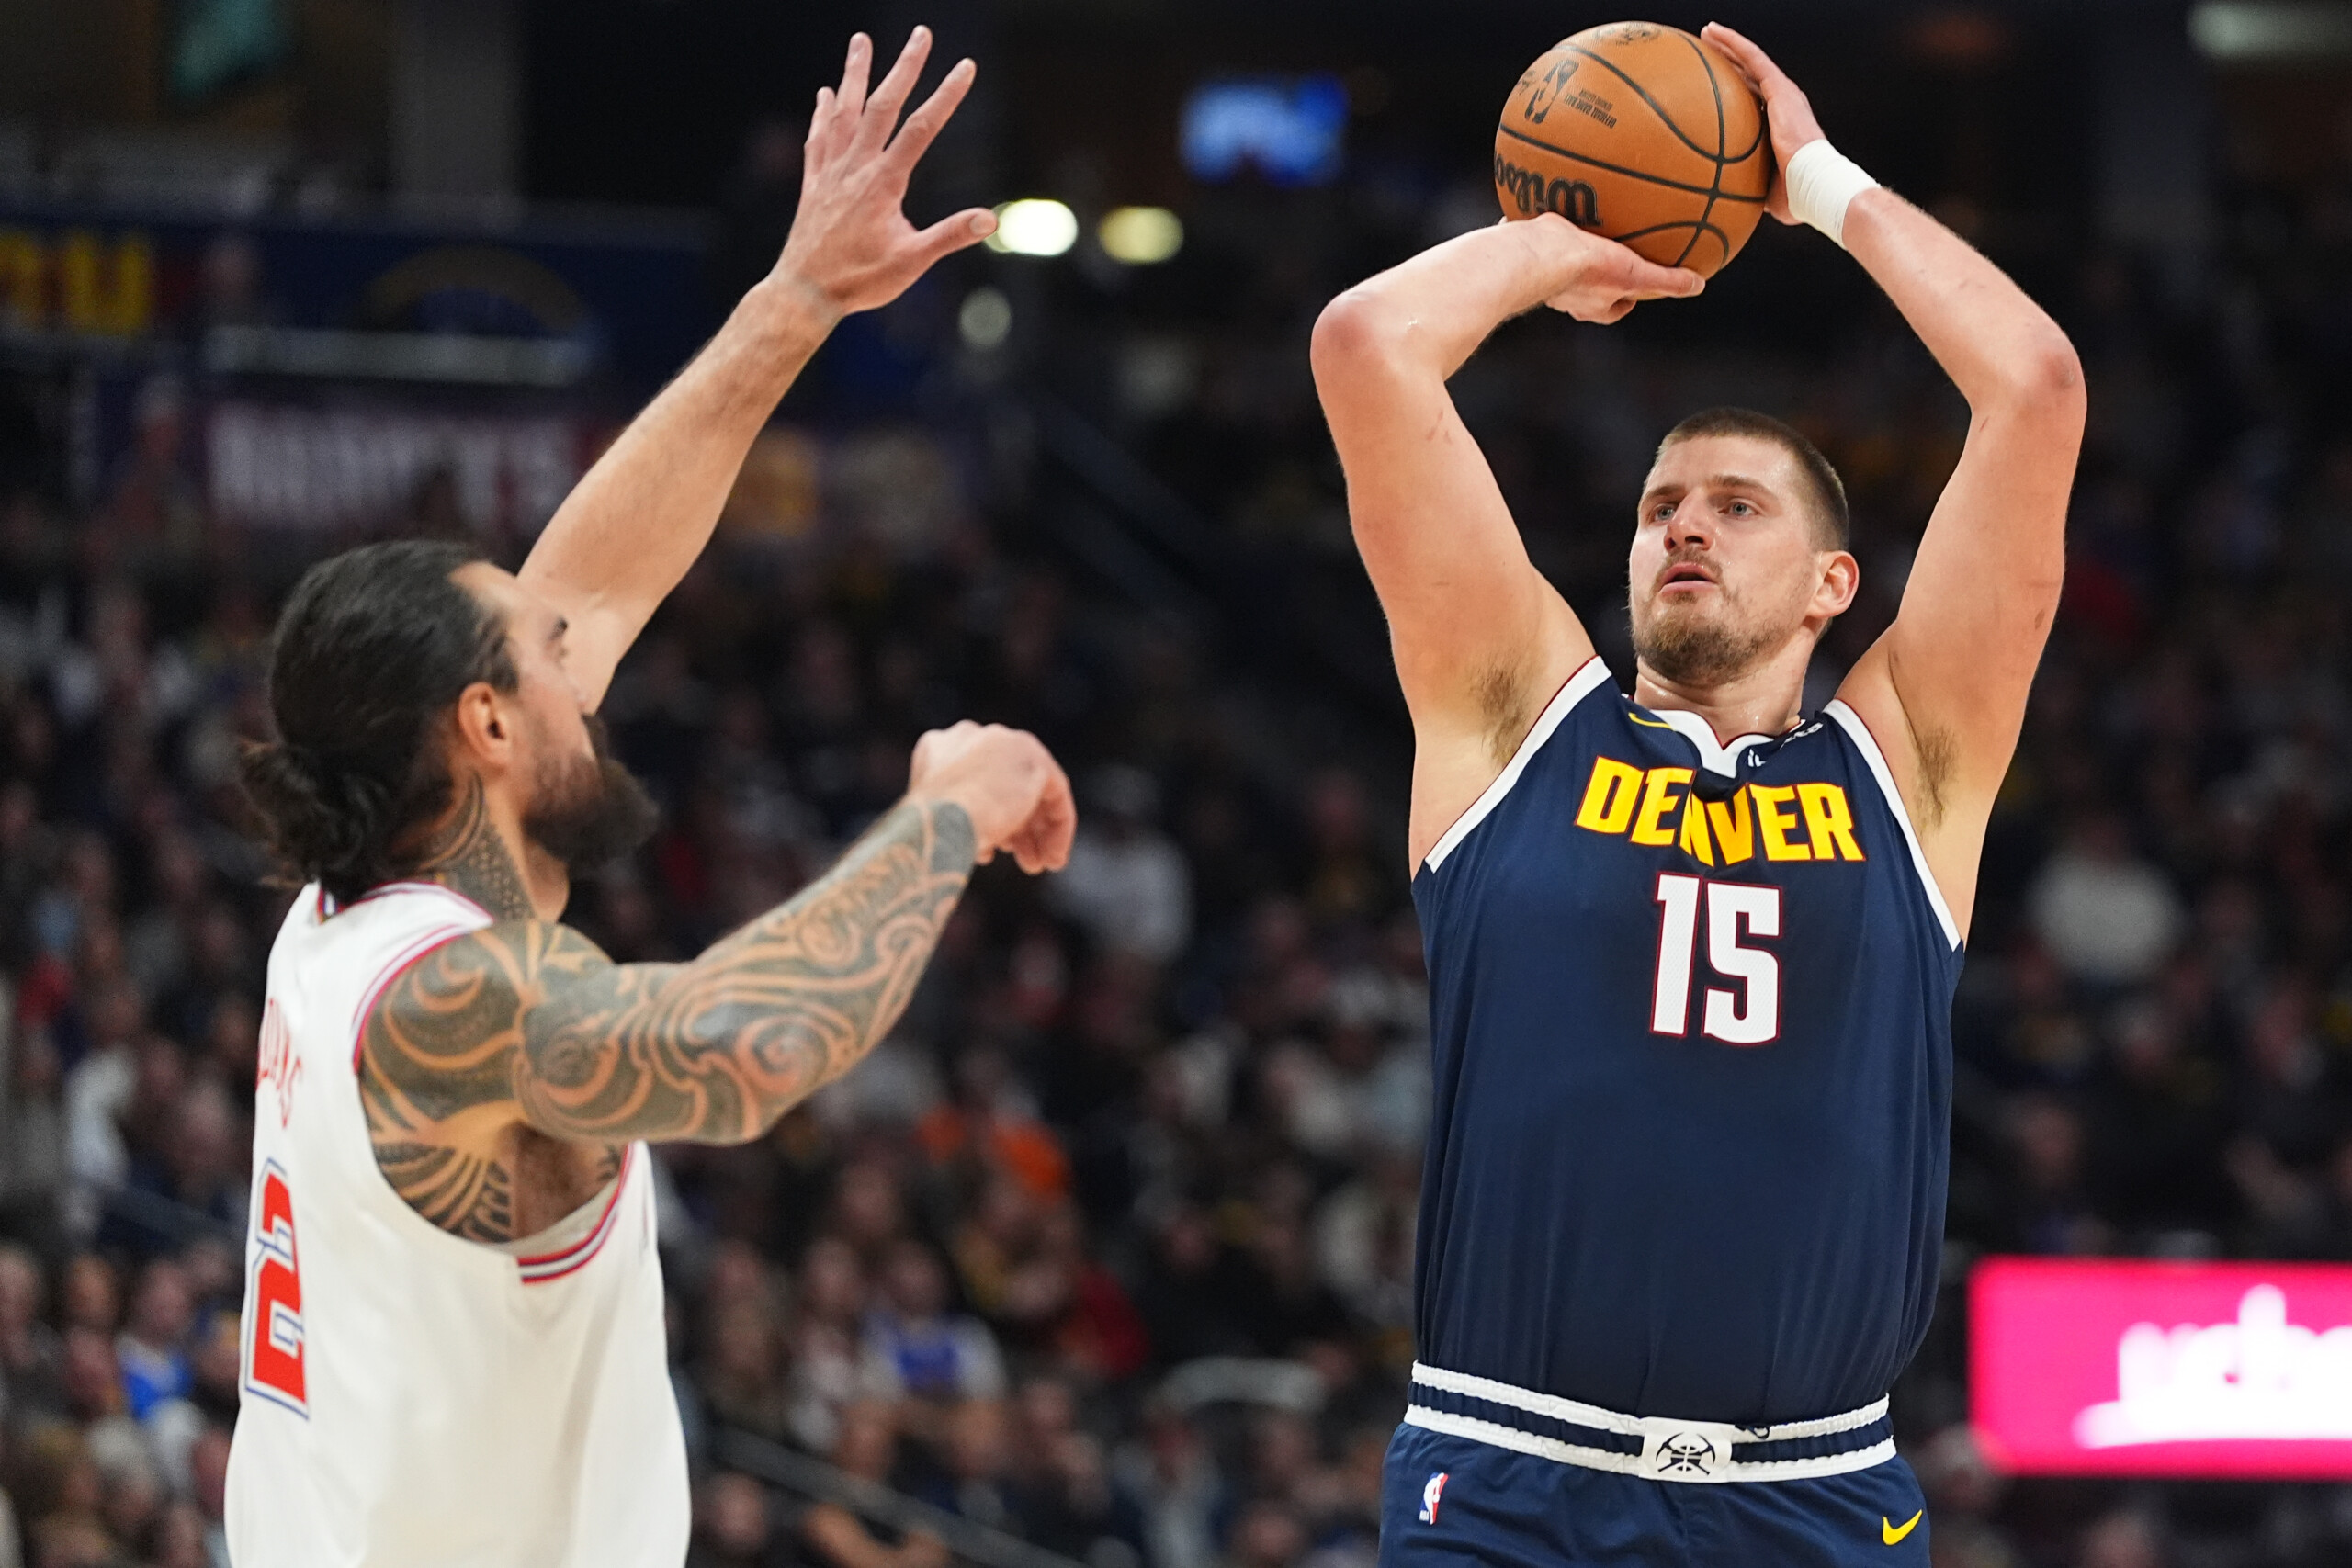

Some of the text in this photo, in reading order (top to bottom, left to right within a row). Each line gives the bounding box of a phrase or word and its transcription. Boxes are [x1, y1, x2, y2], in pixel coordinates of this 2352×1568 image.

[1494, 152, 1603, 228] Wilso
[1574, 755, 1867, 868] DENVER
[1650, 871, 1783, 1046] 15
